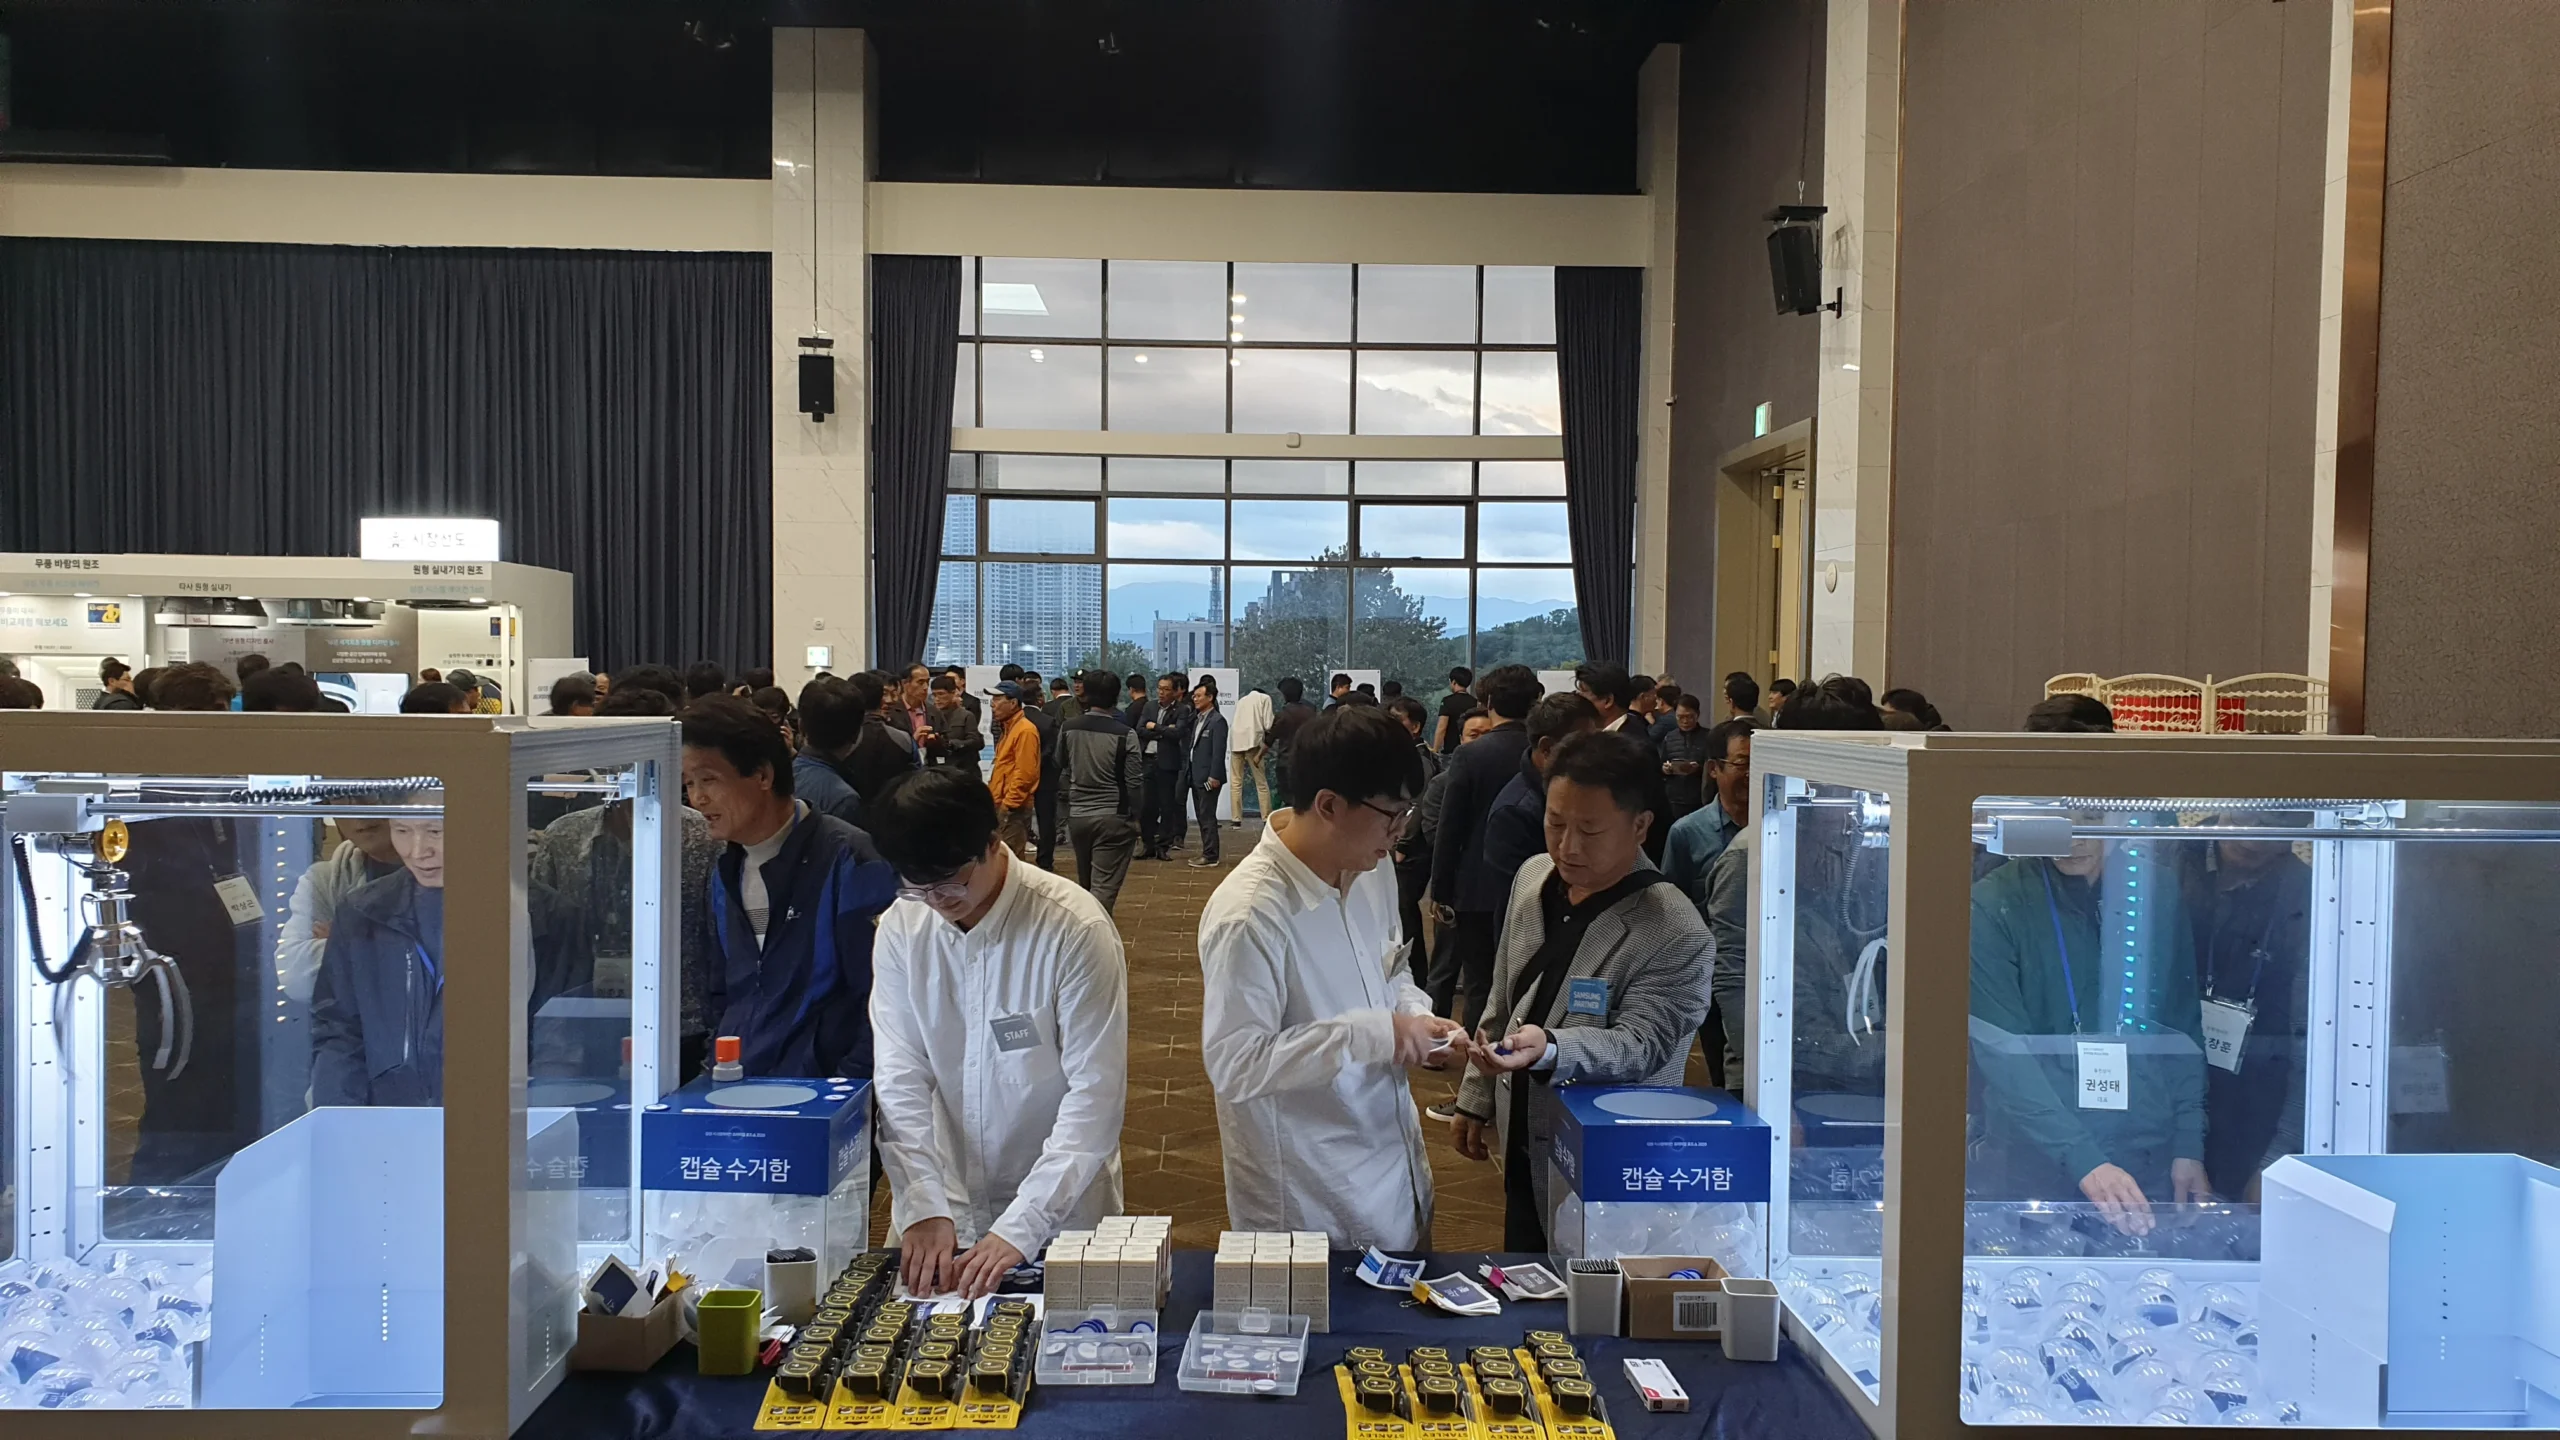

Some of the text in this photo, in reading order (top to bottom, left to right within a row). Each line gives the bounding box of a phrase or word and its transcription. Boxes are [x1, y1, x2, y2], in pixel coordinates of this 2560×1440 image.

[35, 559, 100, 570] 무풍 바람의 원조
[413, 564, 484, 576] 원형 실내기의 원조
[179, 582, 232, 592] 타사 원형 실내기
[1573, 991, 1601, 1001] SAMSUNG
[1573, 1000, 1599, 1009] PARTNER
[1004, 1028, 1029, 1041] STAFF
[2085, 1079, 2120, 1093] 권성태
[680, 1156, 792, 1183] 캡슐 수거함
[1622, 1166, 1733, 1191] 캡슐 수거함
